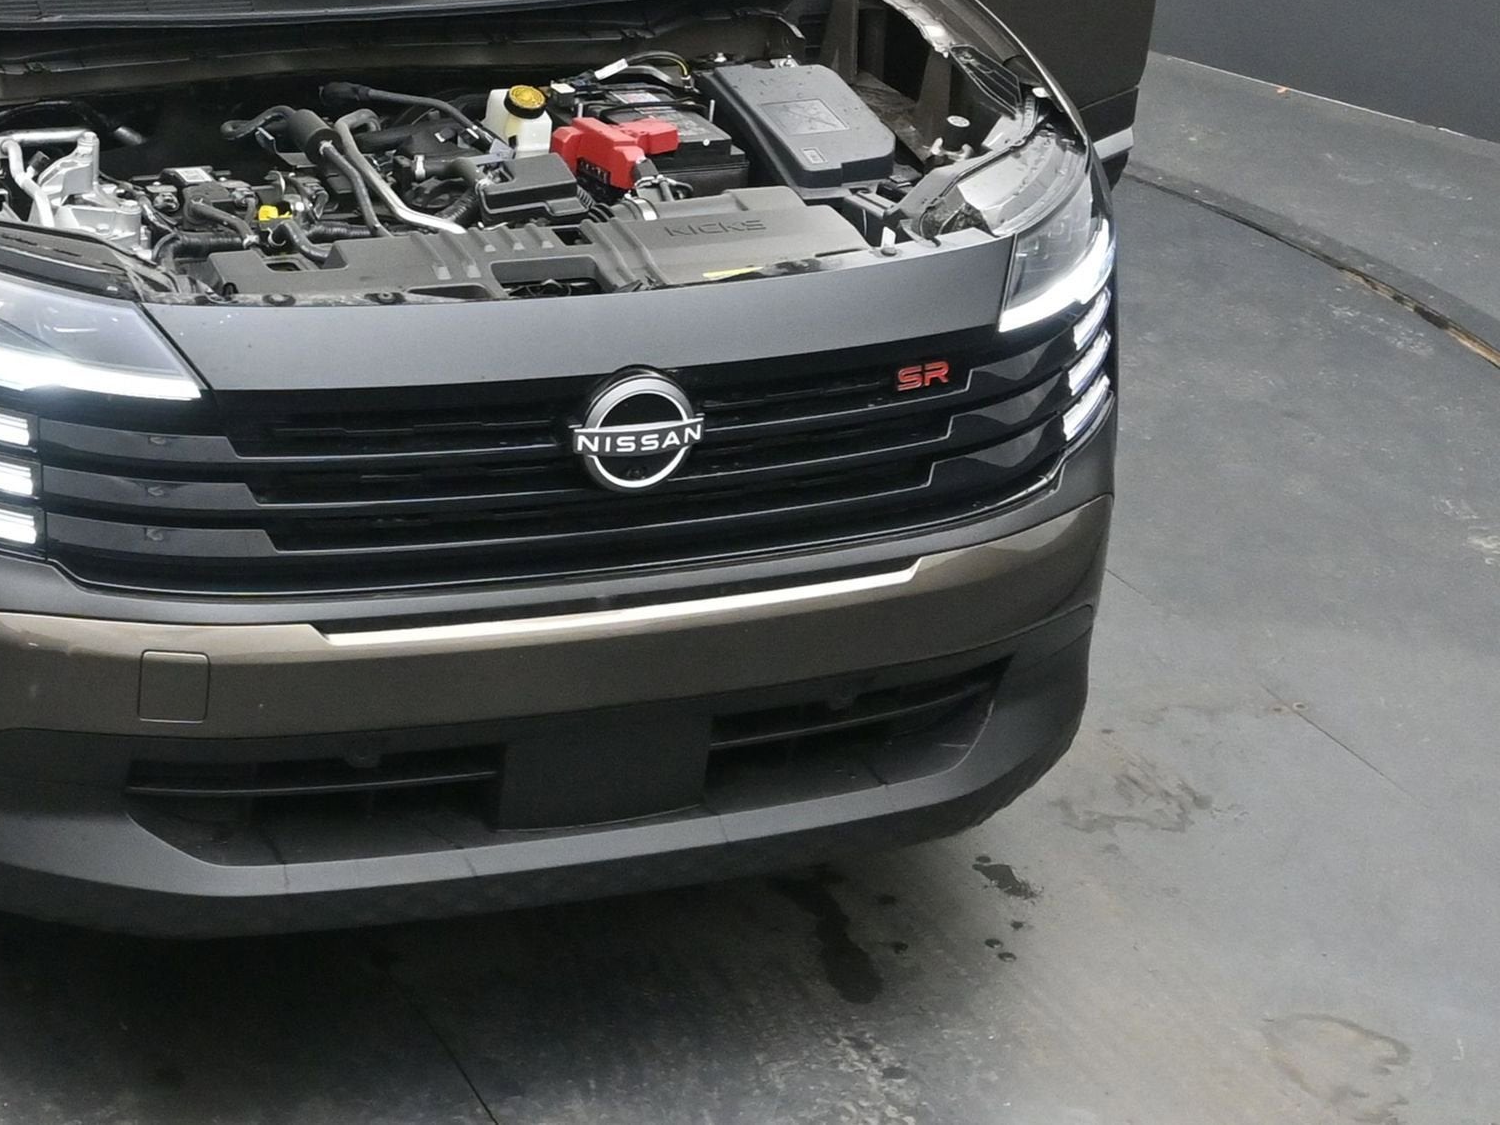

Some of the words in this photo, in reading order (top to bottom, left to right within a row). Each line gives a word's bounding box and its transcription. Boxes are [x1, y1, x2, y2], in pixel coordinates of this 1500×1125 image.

[666, 219, 767, 237] KICKS
[897, 361, 950, 391] SR
[576, 424, 702, 453] NISSAN
